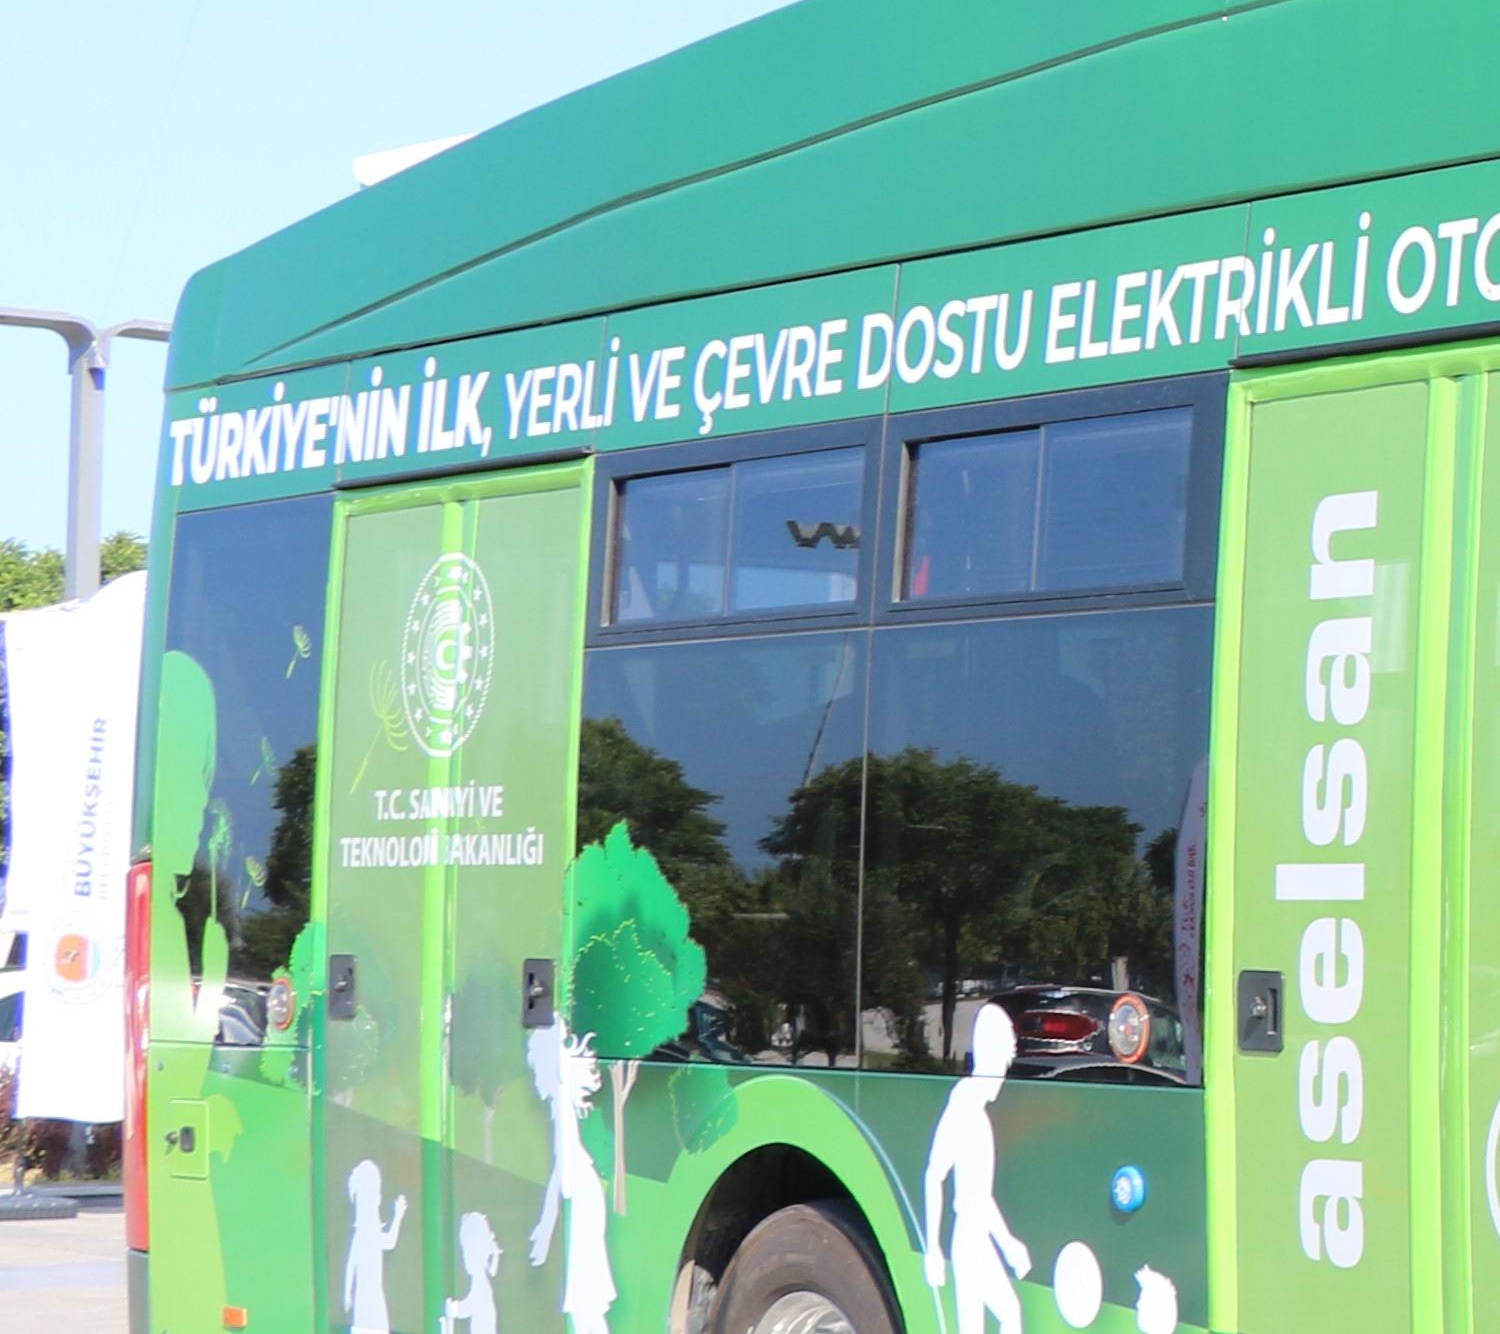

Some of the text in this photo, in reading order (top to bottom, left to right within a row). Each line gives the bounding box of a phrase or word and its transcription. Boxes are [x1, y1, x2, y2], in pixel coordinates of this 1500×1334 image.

[169, 366, 411, 486] TÜRKİYE'NİN
[417, 357, 492, 457] İLK,
[505, 337, 620, 440] YERLİ
[629, 346, 686, 422] VE
[694, 318, 848, 435] ÇEVRE
[857, 289, 1033, 390] DOSTU
[1045, 212, 1371, 364] ELEKTRİKLİ
[340, 827, 438, 868] TEKNOLOJİ
[375, 789, 406, 820] T.C.
[479, 785, 504, 818] VE
[1274, 489, 1380, 1269] aselsan
